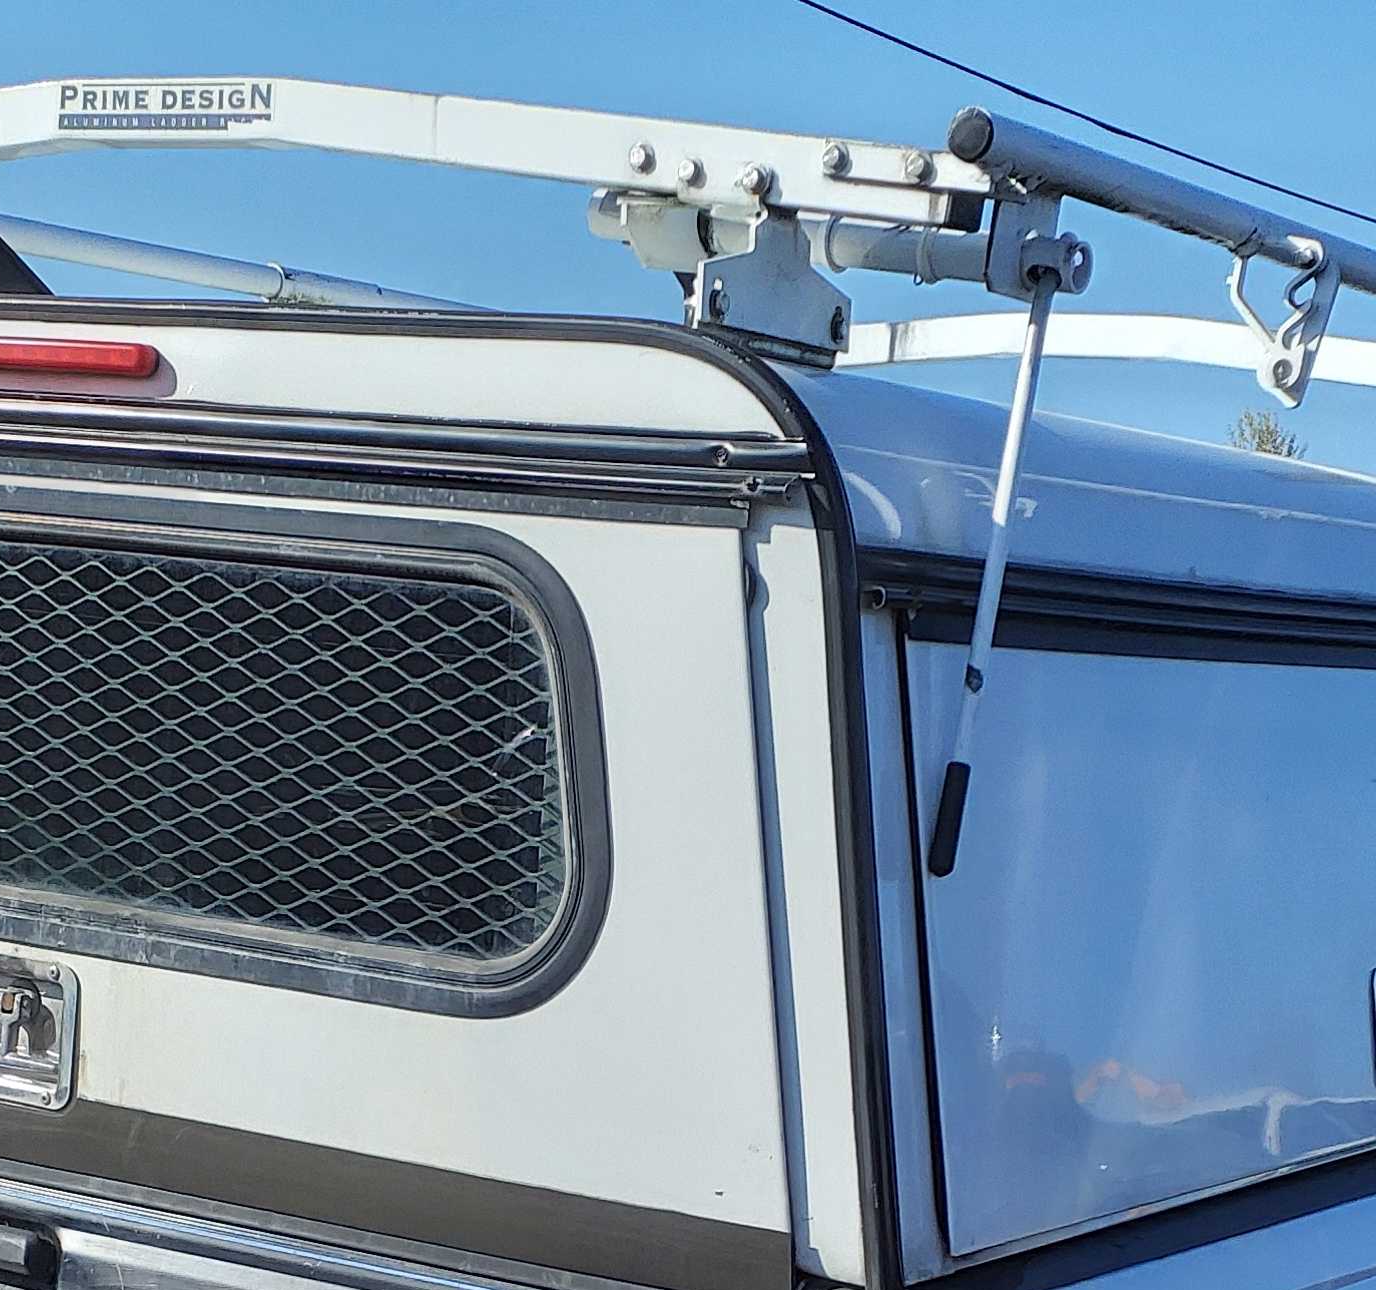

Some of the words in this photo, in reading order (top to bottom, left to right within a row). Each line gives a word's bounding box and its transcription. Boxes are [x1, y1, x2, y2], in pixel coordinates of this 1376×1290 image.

[60, 85, 149, 110] PRIME
[161, 83, 272, 110] DESIGN
[151, 117, 207, 127] LADDER
